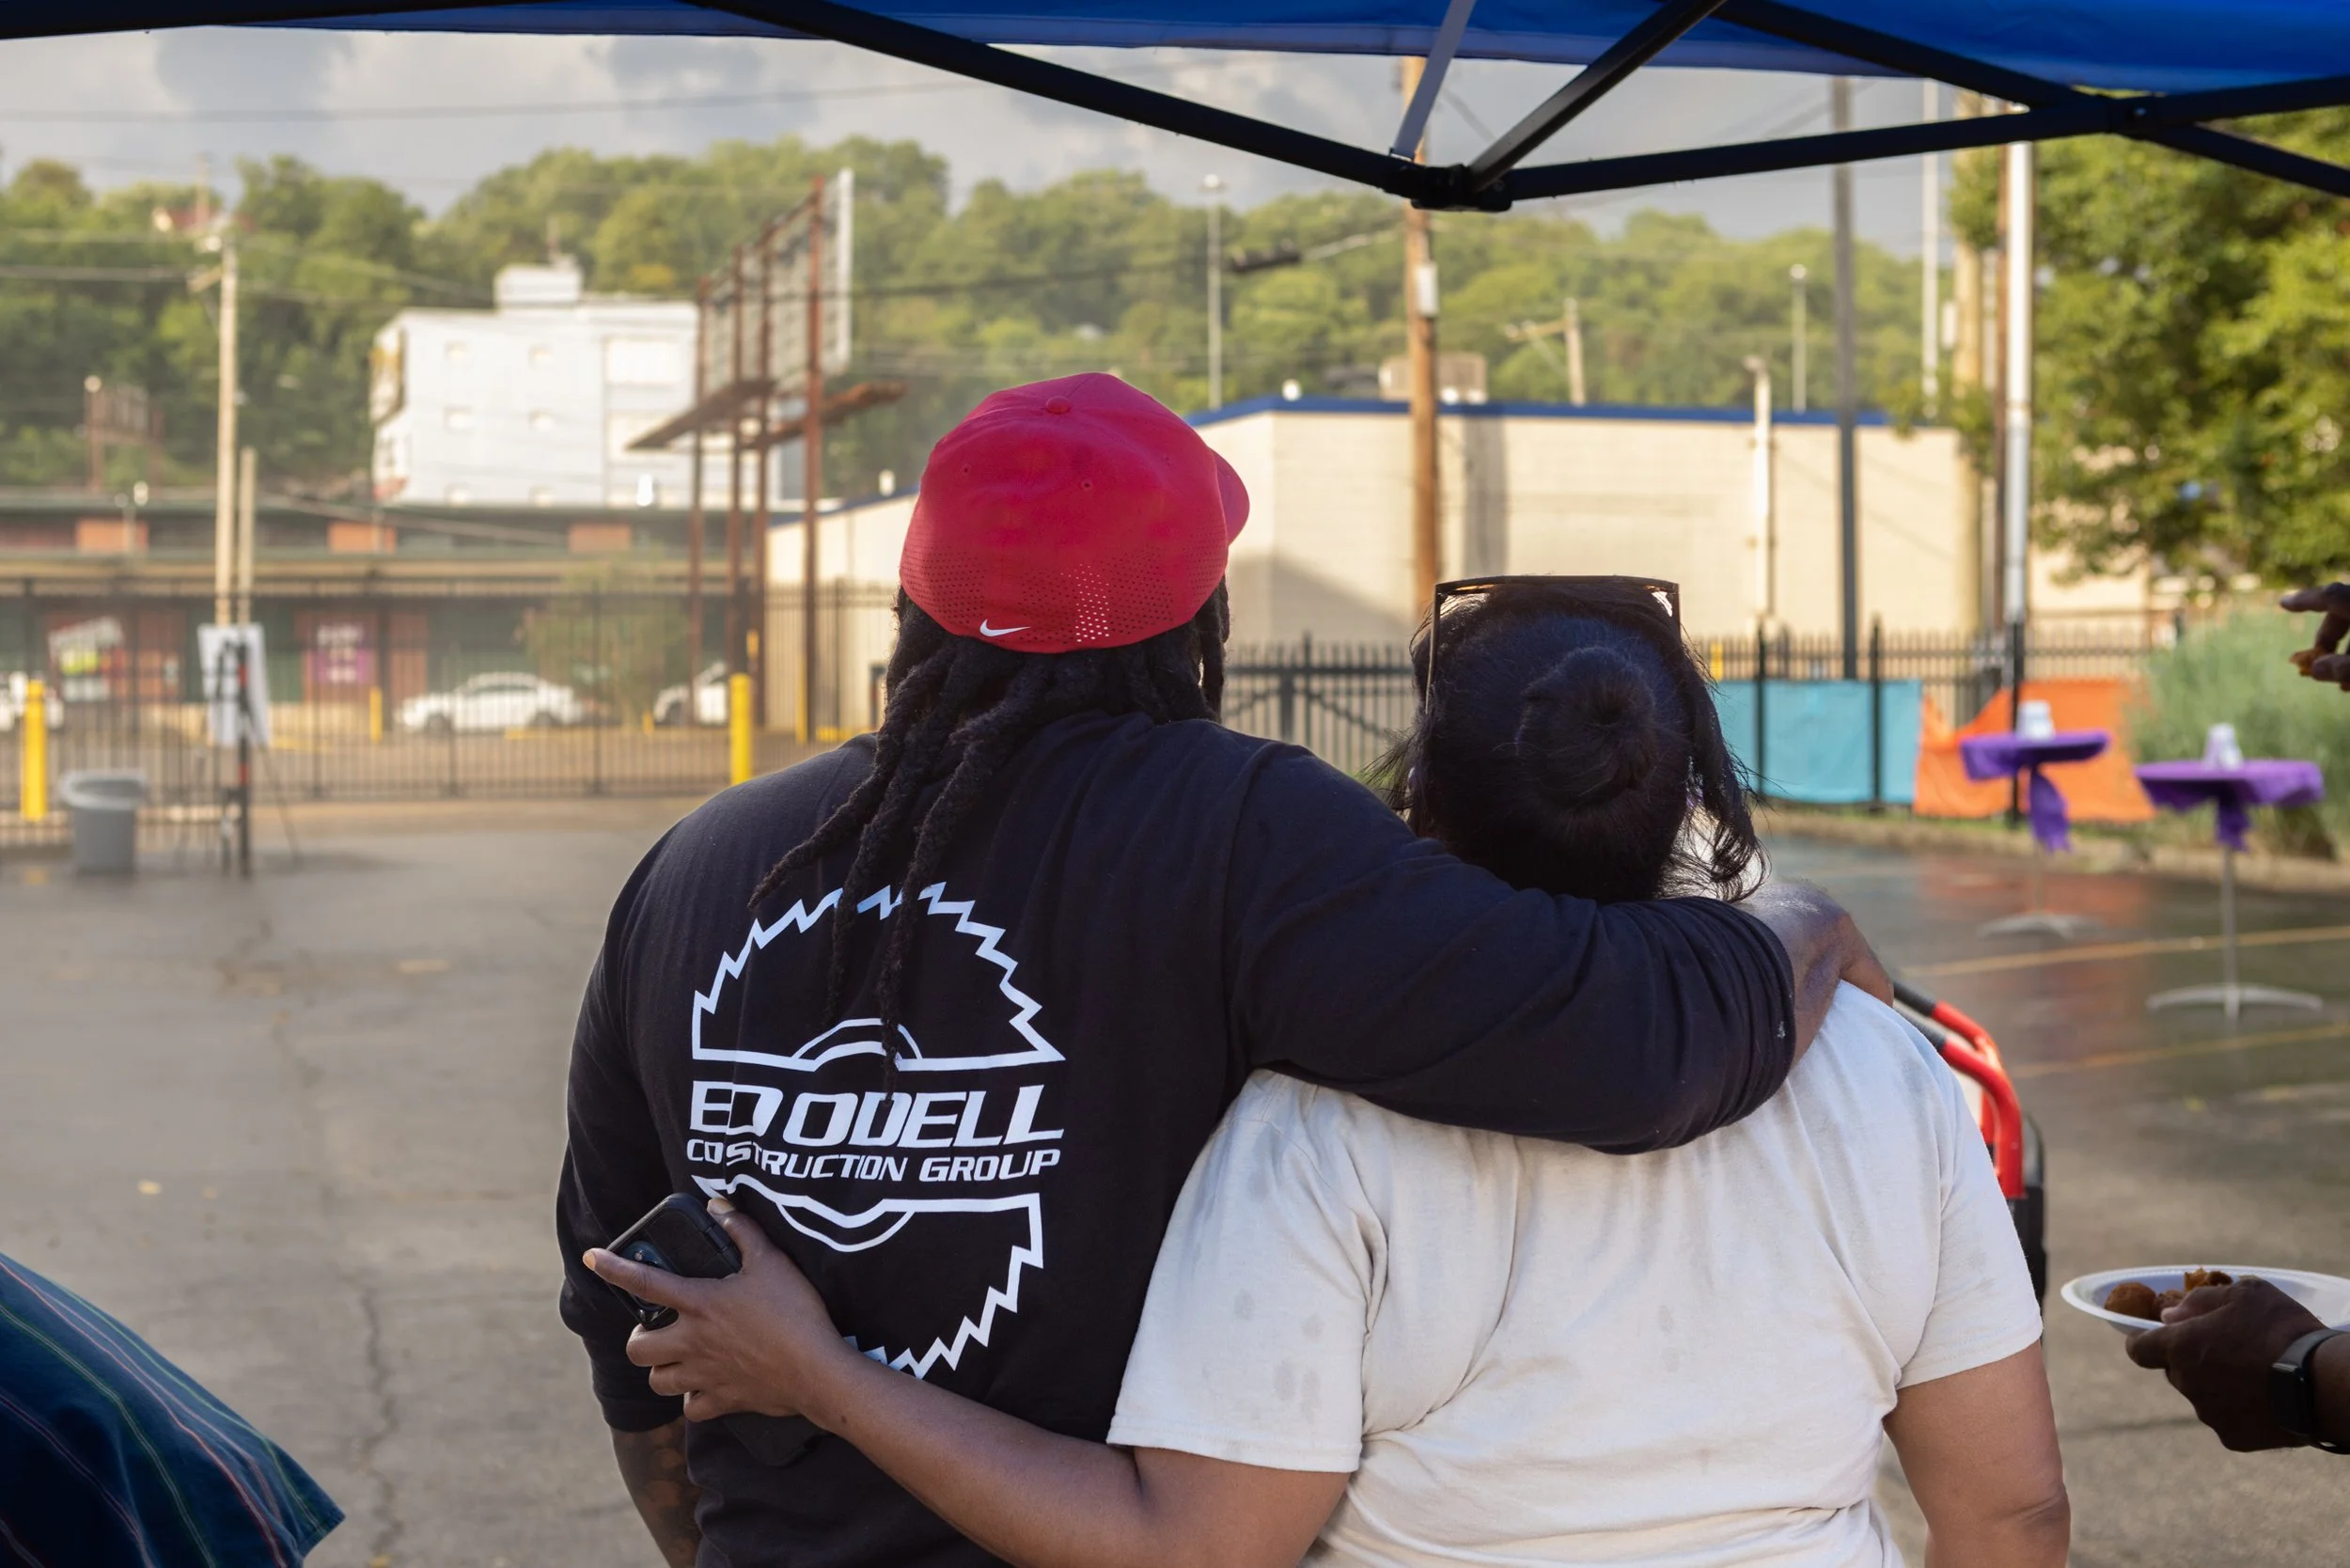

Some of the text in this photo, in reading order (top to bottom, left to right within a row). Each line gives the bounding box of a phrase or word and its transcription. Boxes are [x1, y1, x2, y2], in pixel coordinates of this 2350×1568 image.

[689, 1080, 1065, 1149] ED ODELL
[918, 1149, 1061, 1183] GROUP
